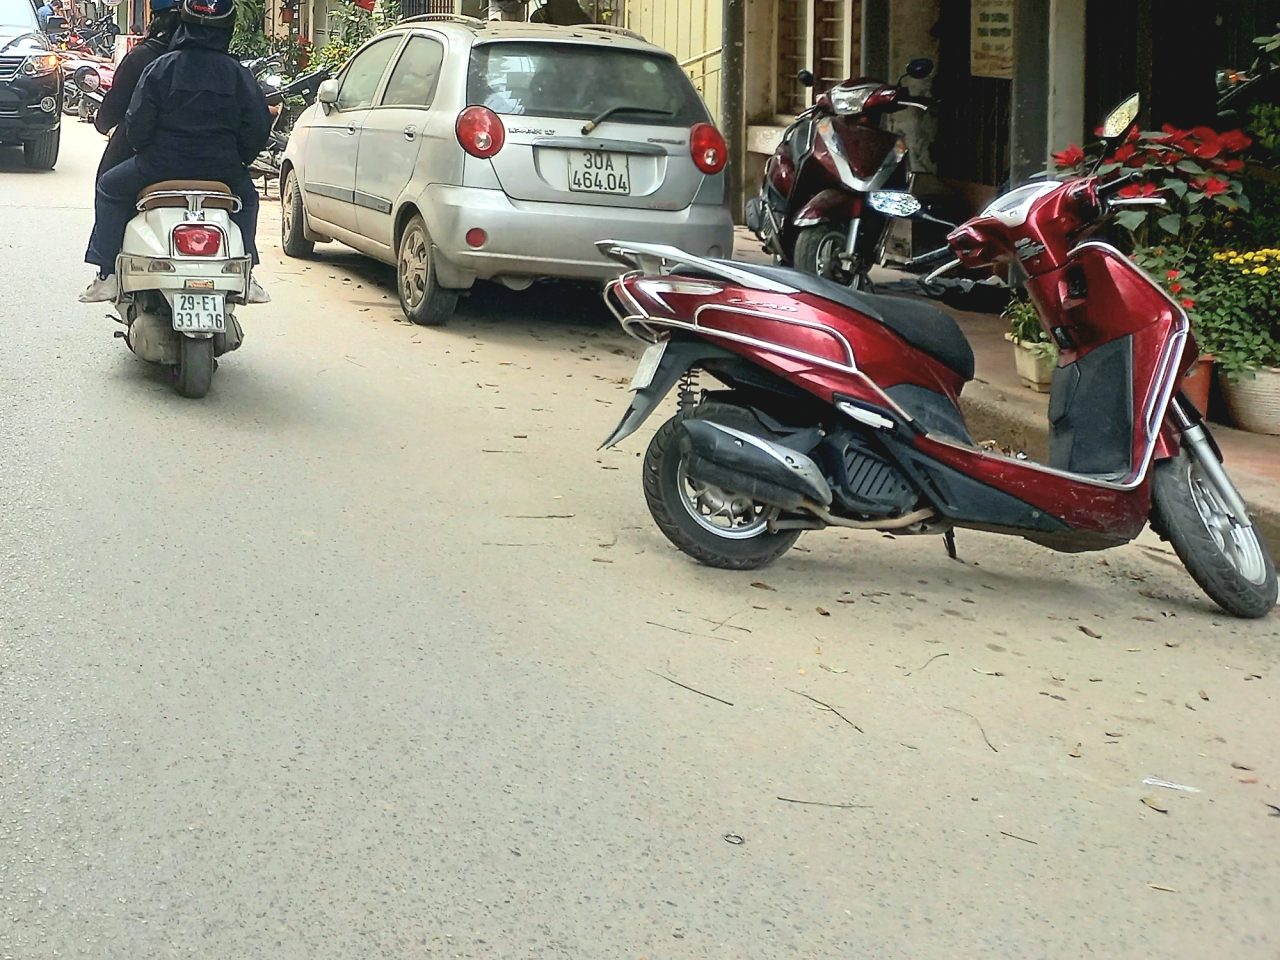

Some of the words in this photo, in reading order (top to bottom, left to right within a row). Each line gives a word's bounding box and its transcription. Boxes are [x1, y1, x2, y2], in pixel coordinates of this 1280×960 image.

[583, 152, 615, 172] 30A
[572, 171, 628, 192] 464.04
[180, 295, 217, 311] 29-E1
